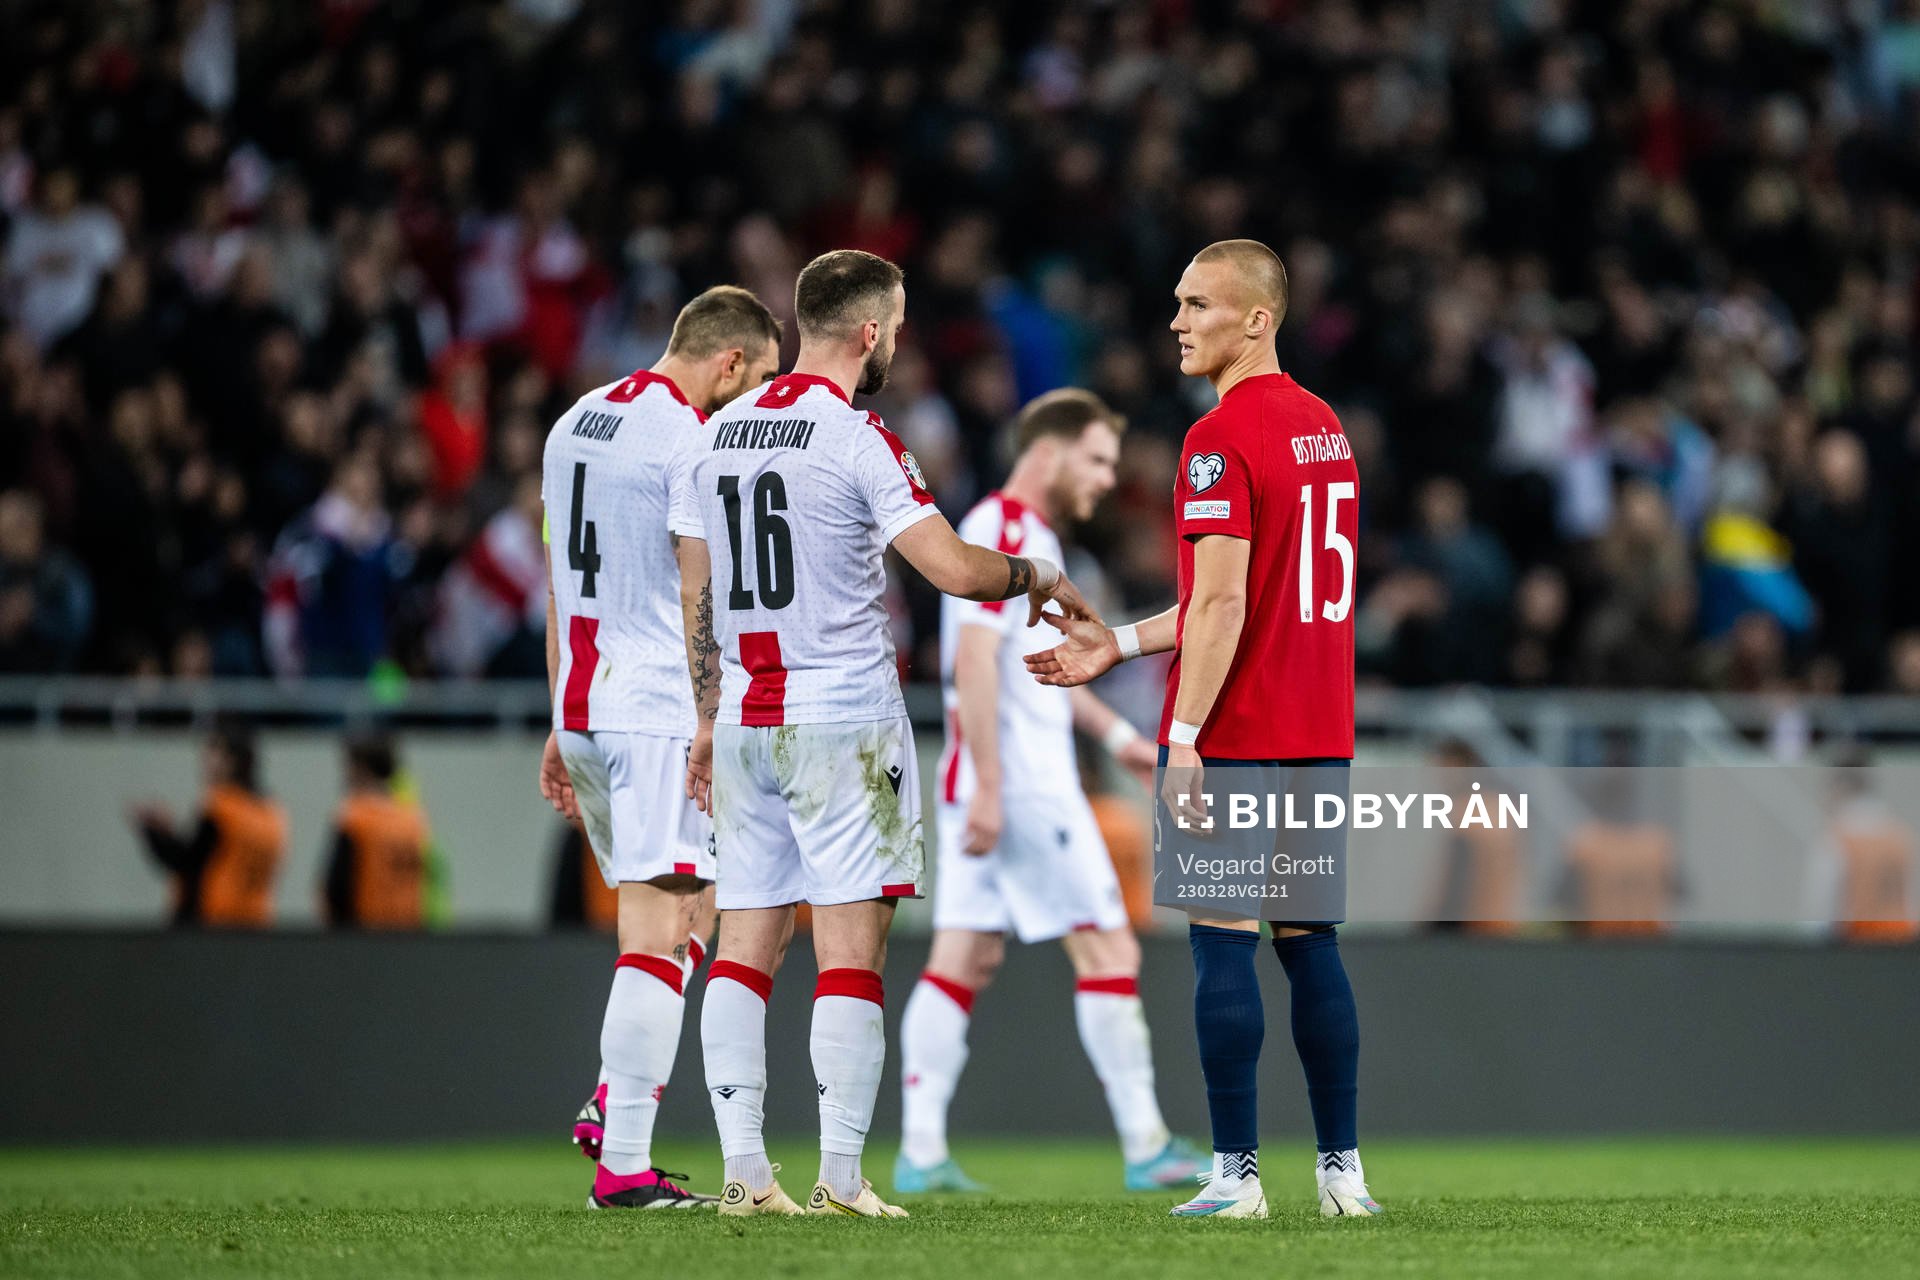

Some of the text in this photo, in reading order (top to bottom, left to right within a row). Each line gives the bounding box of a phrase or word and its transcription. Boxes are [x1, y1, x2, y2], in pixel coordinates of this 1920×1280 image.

[572, 409, 624, 442] KASHIA
[712, 419, 816, 451] KVEKVESKIRI
[1291, 426, 1351, 465] ØSTIGÅRD
[1184, 505, 1228, 513] OUNDATION
[568, 462, 601, 598] 4
[717, 471, 795, 611] 16
[1298, 481, 1355, 622] 15
